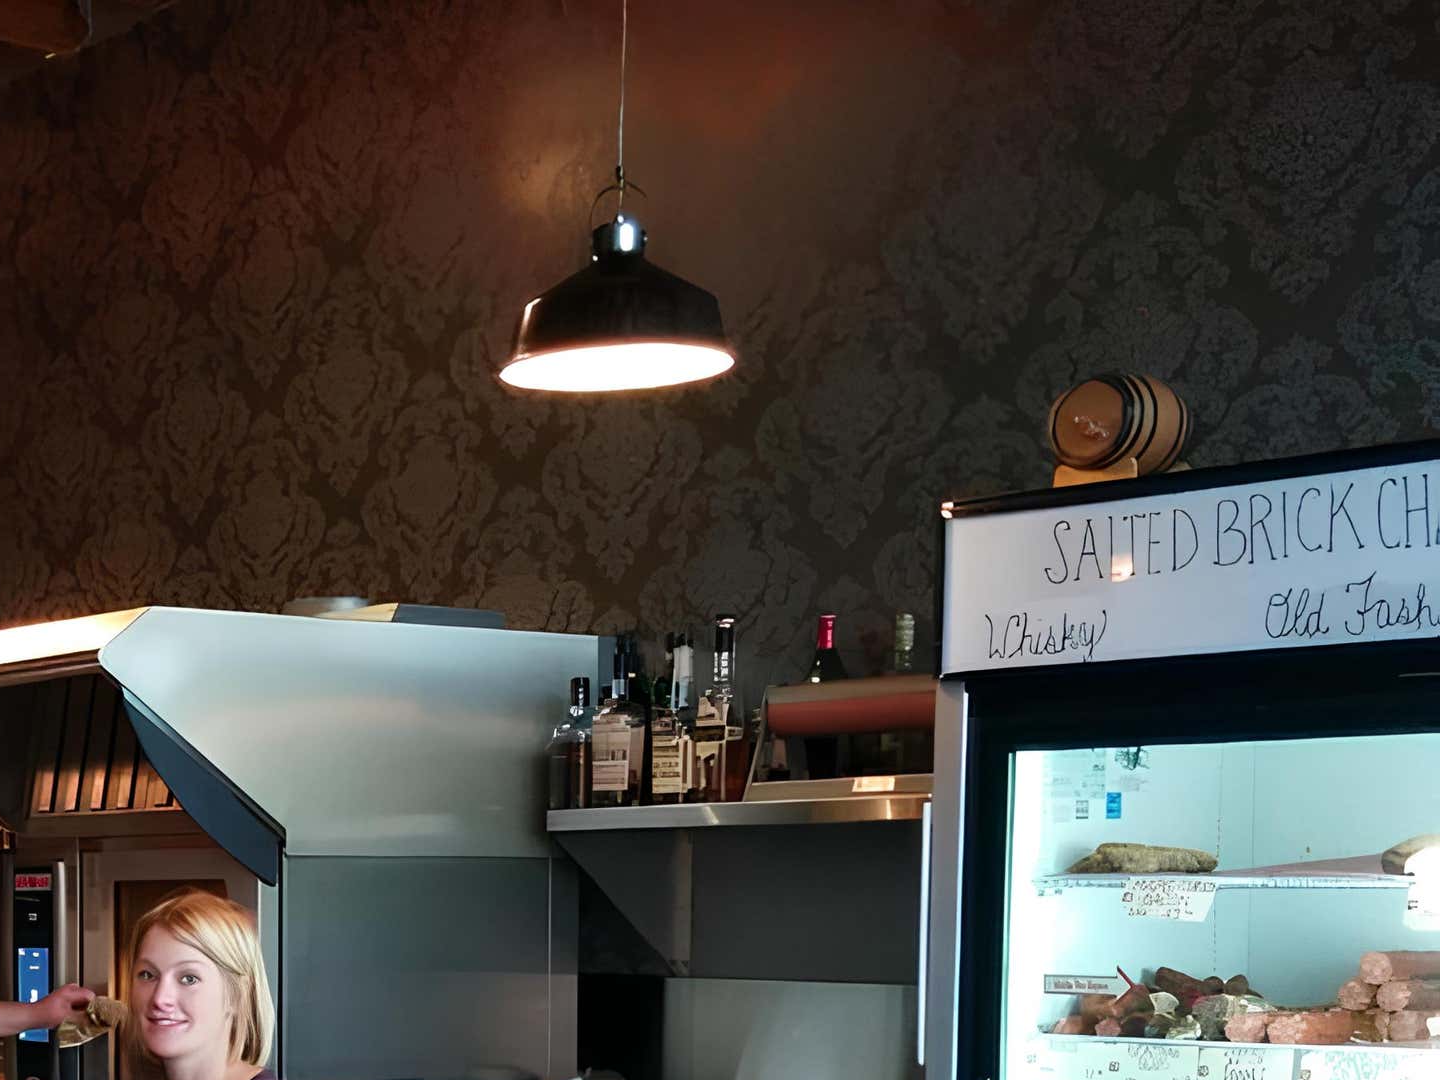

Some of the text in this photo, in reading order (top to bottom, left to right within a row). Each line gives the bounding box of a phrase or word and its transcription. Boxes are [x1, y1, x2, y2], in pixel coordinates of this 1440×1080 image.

[1044, 473, 1440, 584] SALTED BRICK CH
[1264, 570, 1440, 639] Old Fash
